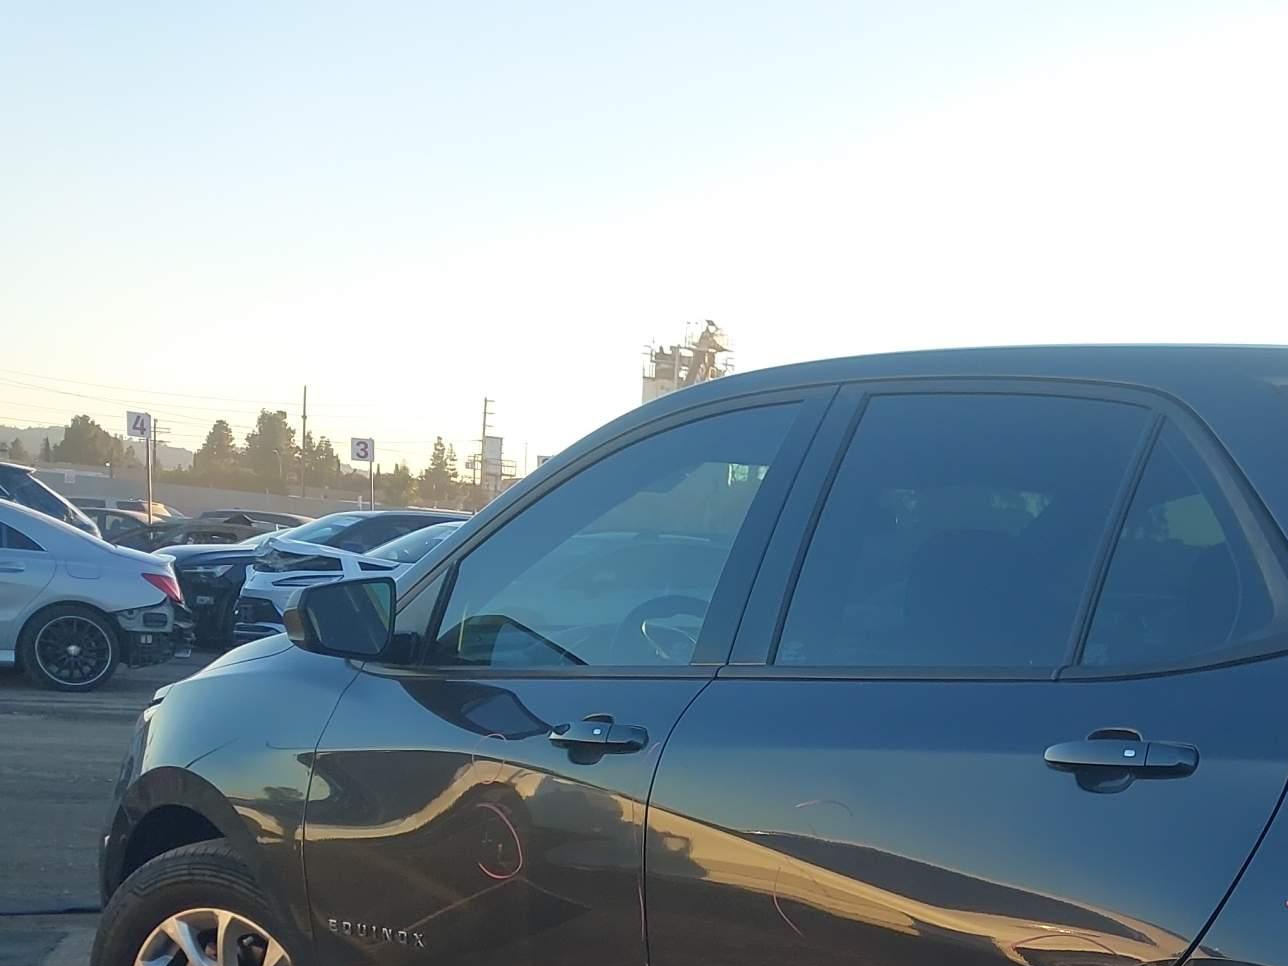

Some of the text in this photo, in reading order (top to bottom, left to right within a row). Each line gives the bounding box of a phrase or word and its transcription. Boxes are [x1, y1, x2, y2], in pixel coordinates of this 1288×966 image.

[132, 415, 146, 436] 4
[356, 441, 369, 459] 3
[328, 919, 425, 948] EQUINOX
